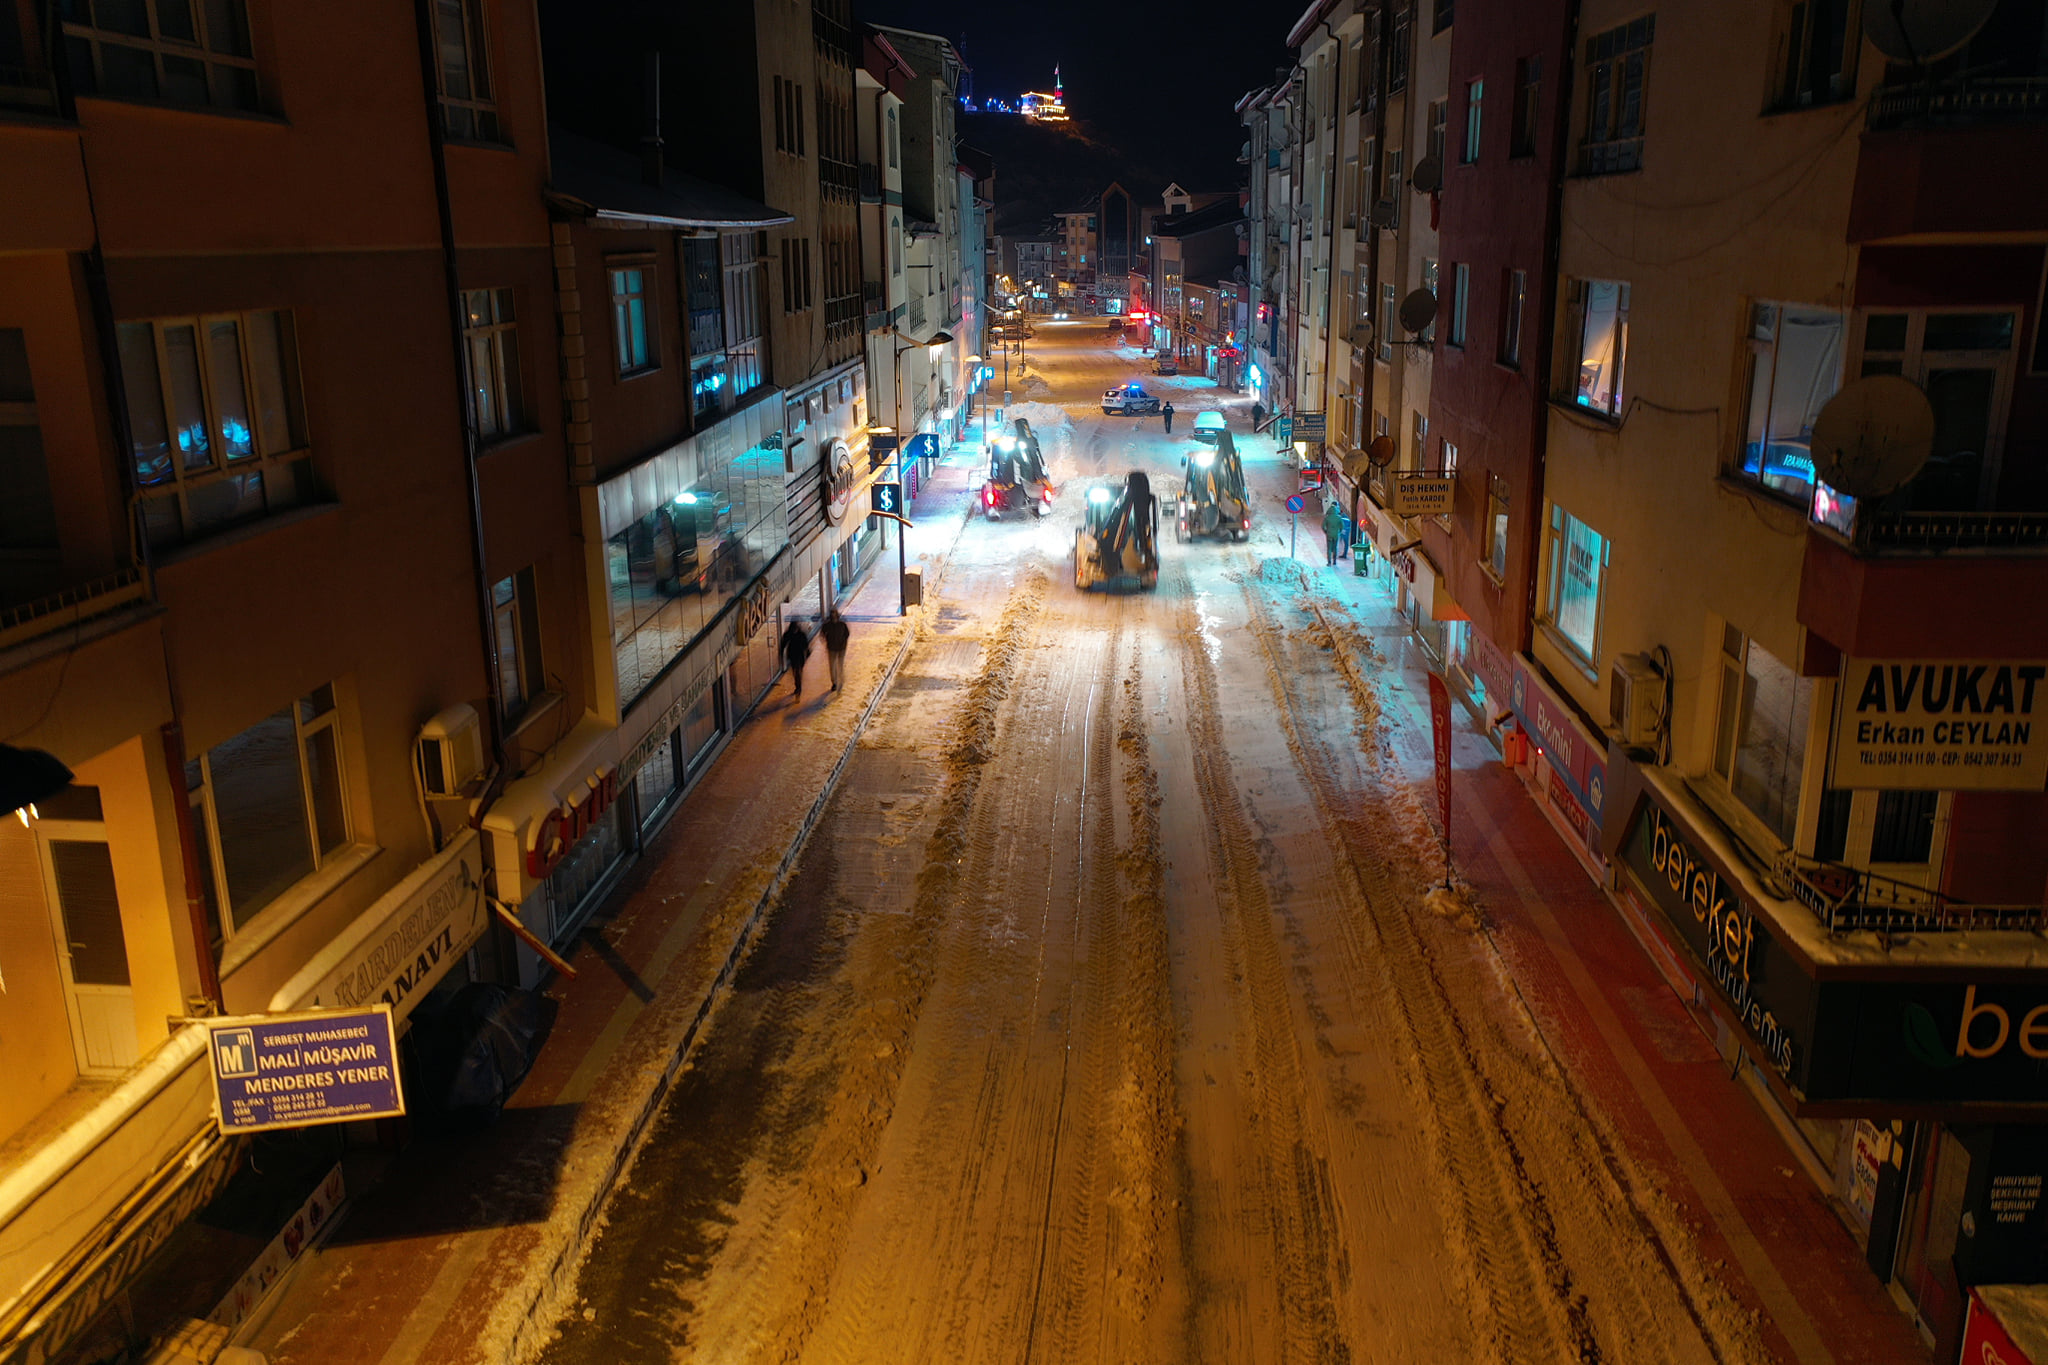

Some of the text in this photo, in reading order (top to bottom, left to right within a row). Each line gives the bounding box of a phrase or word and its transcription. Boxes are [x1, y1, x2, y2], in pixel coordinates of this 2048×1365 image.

[1856, 664, 2047, 714] AVUKAT
[1857, 721, 2031, 745] Erkan CEYLAN
[1859, 751, 1876, 765] TEL:
[1877, 751, 1897, 766] 0354
[1899, 751, 1913, 766] 314
[1915, 751, 1924, 766] 11
[1926, 751, 1935, 766] 00
[1942, 751, 1961, 766] CEP:
[1964, 751, 1982, 766] 0542
[1652, 808, 1755, 982] bereket
[334, 873, 461, 1007] KARDELEN
[381, 924, 454, 1010] ANAVI
[263, 1025, 369, 1047] SERBEST MUHASEBECİ
[259, 1042, 377, 1071] MALİ MÜŞAVİR
[245, 1066, 389, 1095] MENDERES YENER
[1996, 1212, 2027, 1224] KAHVE
